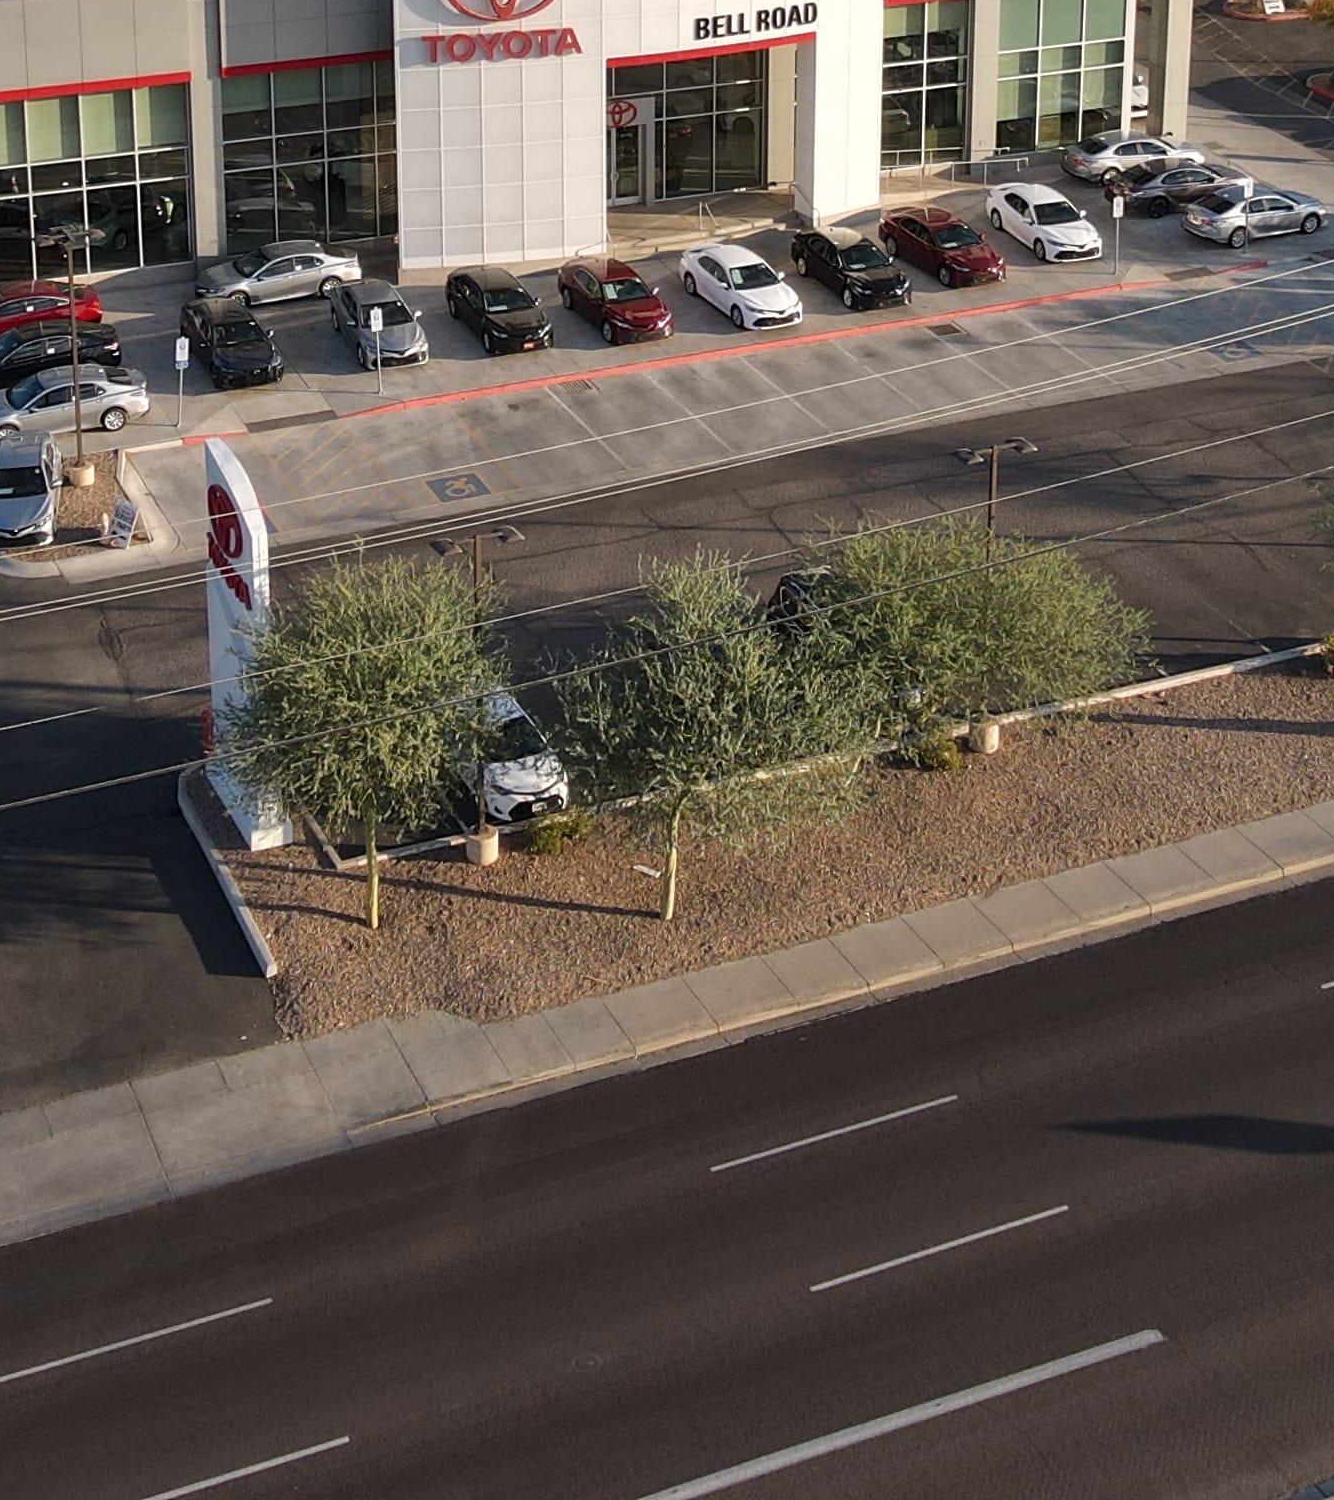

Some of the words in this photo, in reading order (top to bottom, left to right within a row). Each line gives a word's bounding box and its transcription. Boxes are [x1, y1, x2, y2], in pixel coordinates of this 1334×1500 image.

[693, 16, 751, 41] BELL
[755, 2, 818, 32] ROAD
[420, 27, 583, 64] TOYOTA
